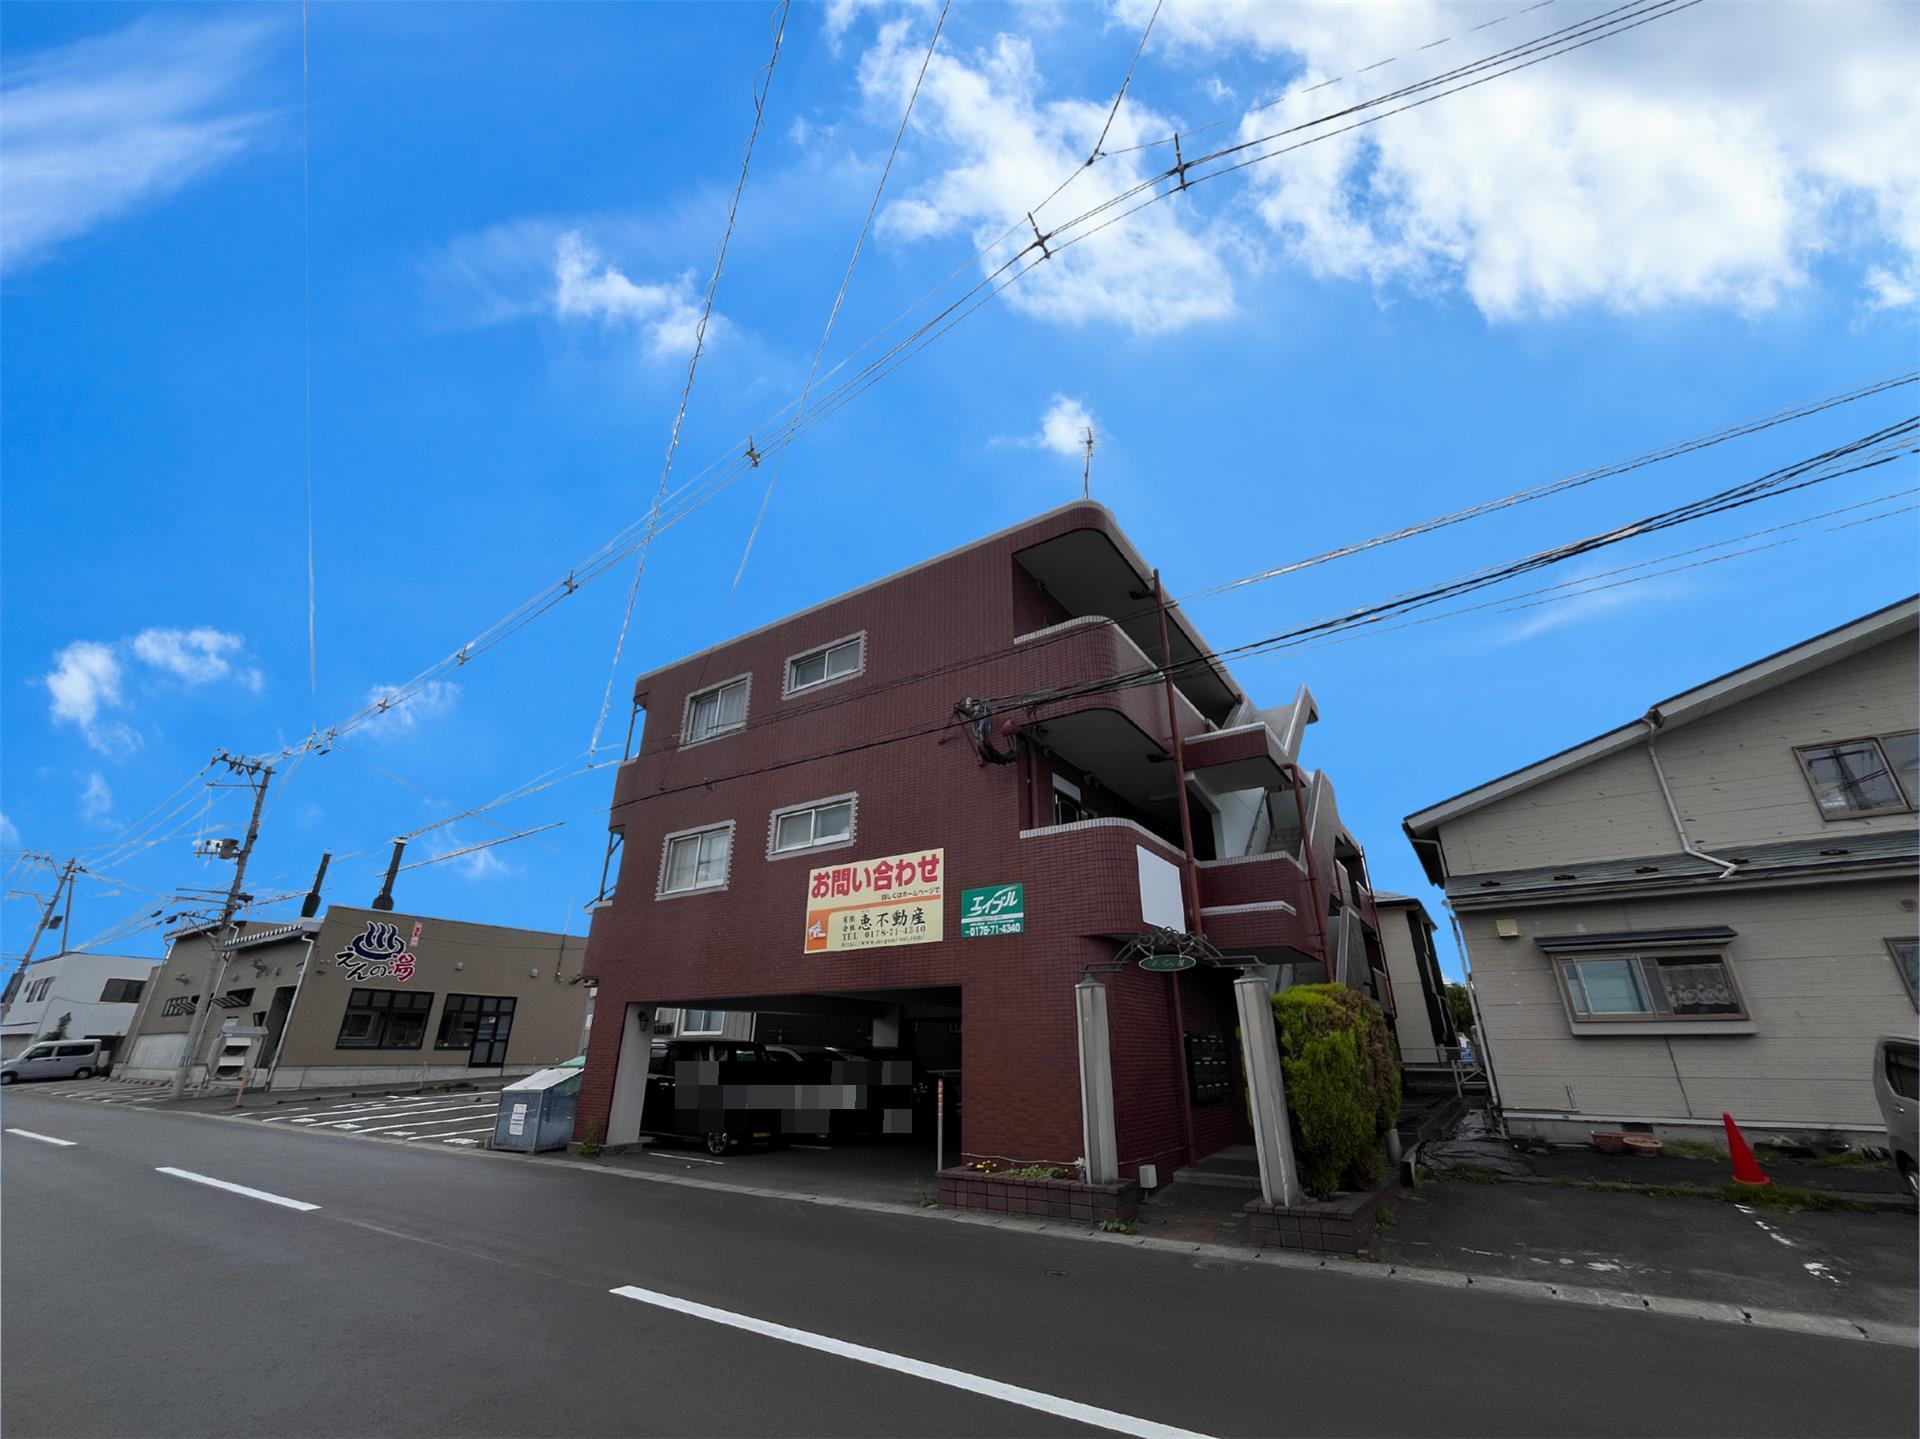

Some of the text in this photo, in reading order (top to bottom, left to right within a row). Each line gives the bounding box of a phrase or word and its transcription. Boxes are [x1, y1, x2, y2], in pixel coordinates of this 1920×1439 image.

[811, 853, 940, 899] お問い合わせ
[967, 885, 1018, 916] エイブル
[858, 907, 926, 931] 恵不動産
[970, 923, 1021, 936] 0178-71-4340
[842, 932, 857, 942] TEL
